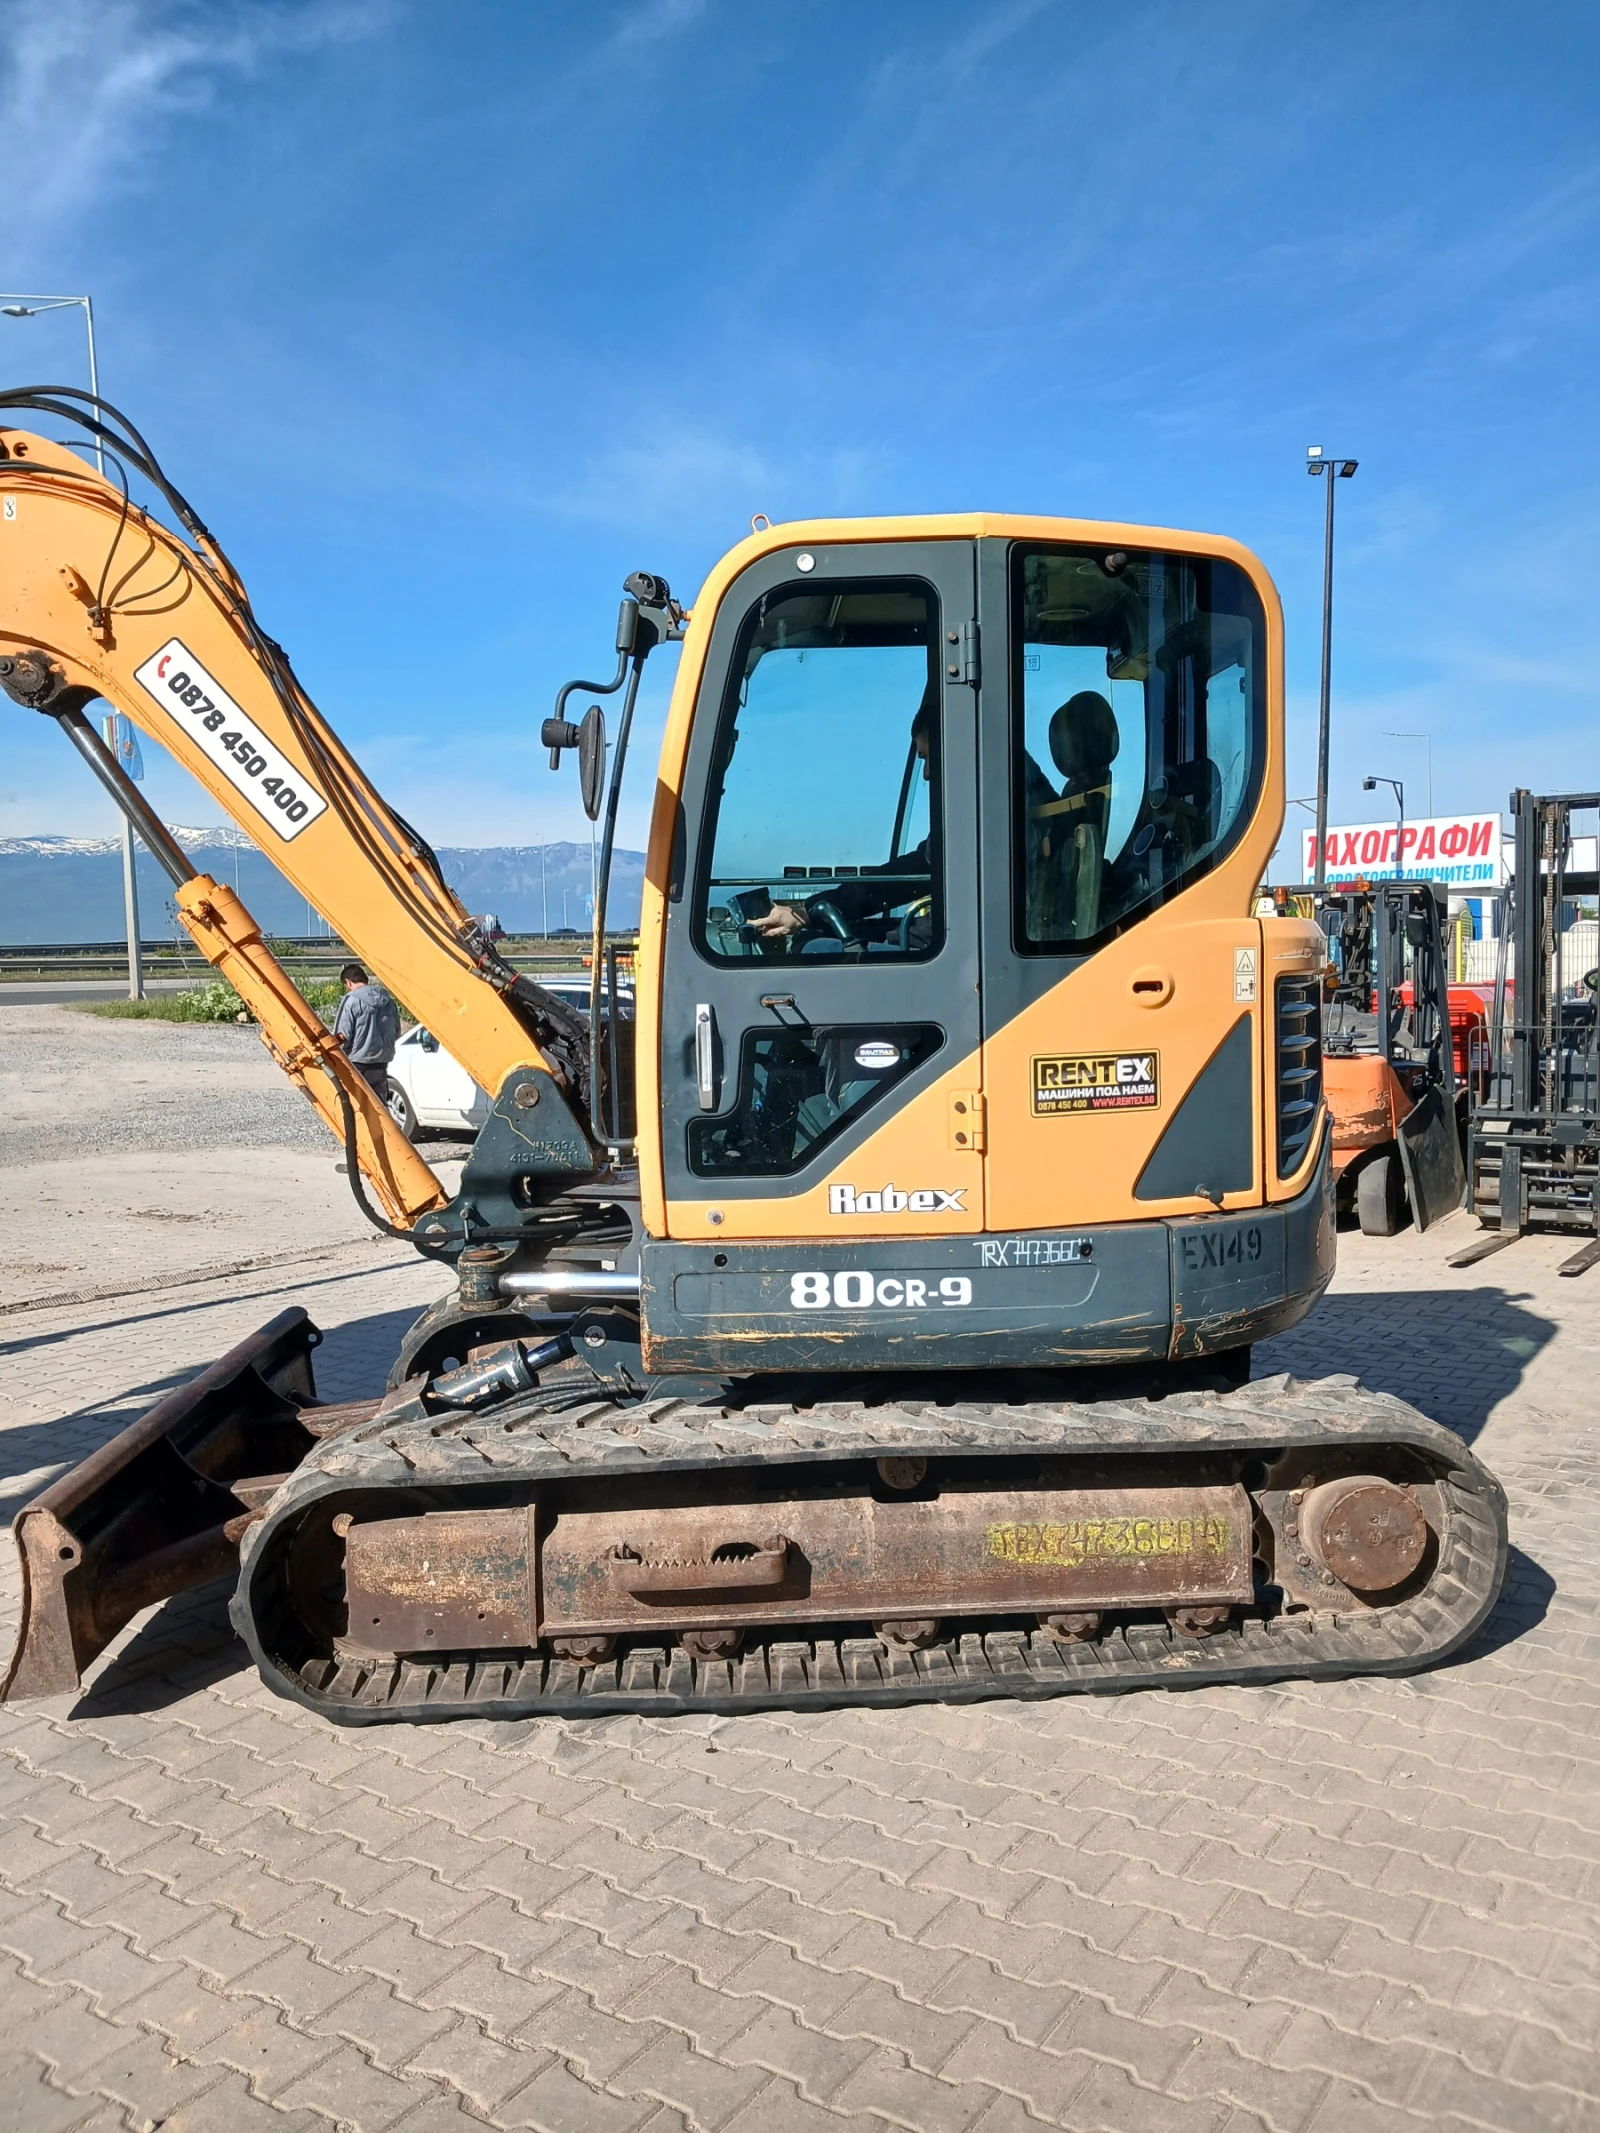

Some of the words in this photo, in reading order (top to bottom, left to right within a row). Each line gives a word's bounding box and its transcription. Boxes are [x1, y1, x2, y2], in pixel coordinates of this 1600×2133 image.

[168, 672, 226, 732] 0878
[220, 731, 267, 777] 450
[261, 777, 309, 823] 400
[1307, 821, 1494, 868] ТАХОГРАФИ
[1040, 1057, 1152, 1086] RENTEX
[1038, 1088, 1094, 1101] МАШИНИ
[1096, 1086, 1121, 1097] ПОД
[1122, 1084, 1155, 1095] НАЕМ
[1038, 1101, 1056, 1111] 0878
[1057, 1101, 1071, 1109] 450
[1073, 1100, 1088, 1108] 400
[828, 1183, 968, 1214] Robex
[1181, 1227, 1262, 1270] EX149
[790, 1271, 972, 1309] 80CR-9
